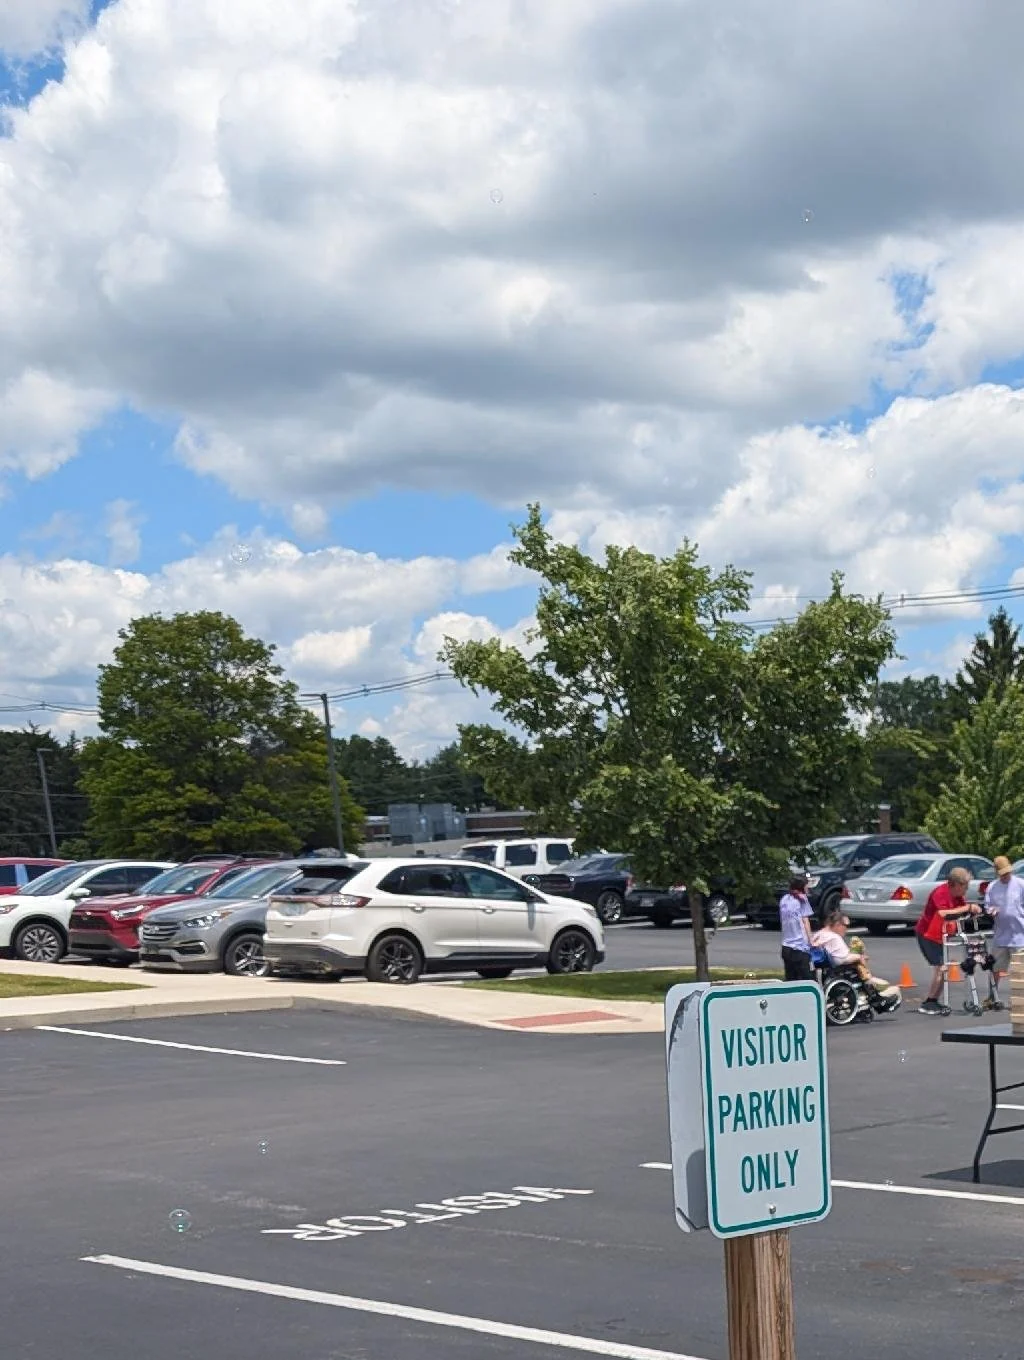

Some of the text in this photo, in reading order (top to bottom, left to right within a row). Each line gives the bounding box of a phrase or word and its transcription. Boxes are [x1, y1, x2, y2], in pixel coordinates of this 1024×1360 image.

[721, 1023, 807, 1069] VISITOR
[718, 1085, 816, 1134] PARKING
[741, 1149, 799, 1194] ONLY
[260, 1185, 595, 1241] VISITOR
